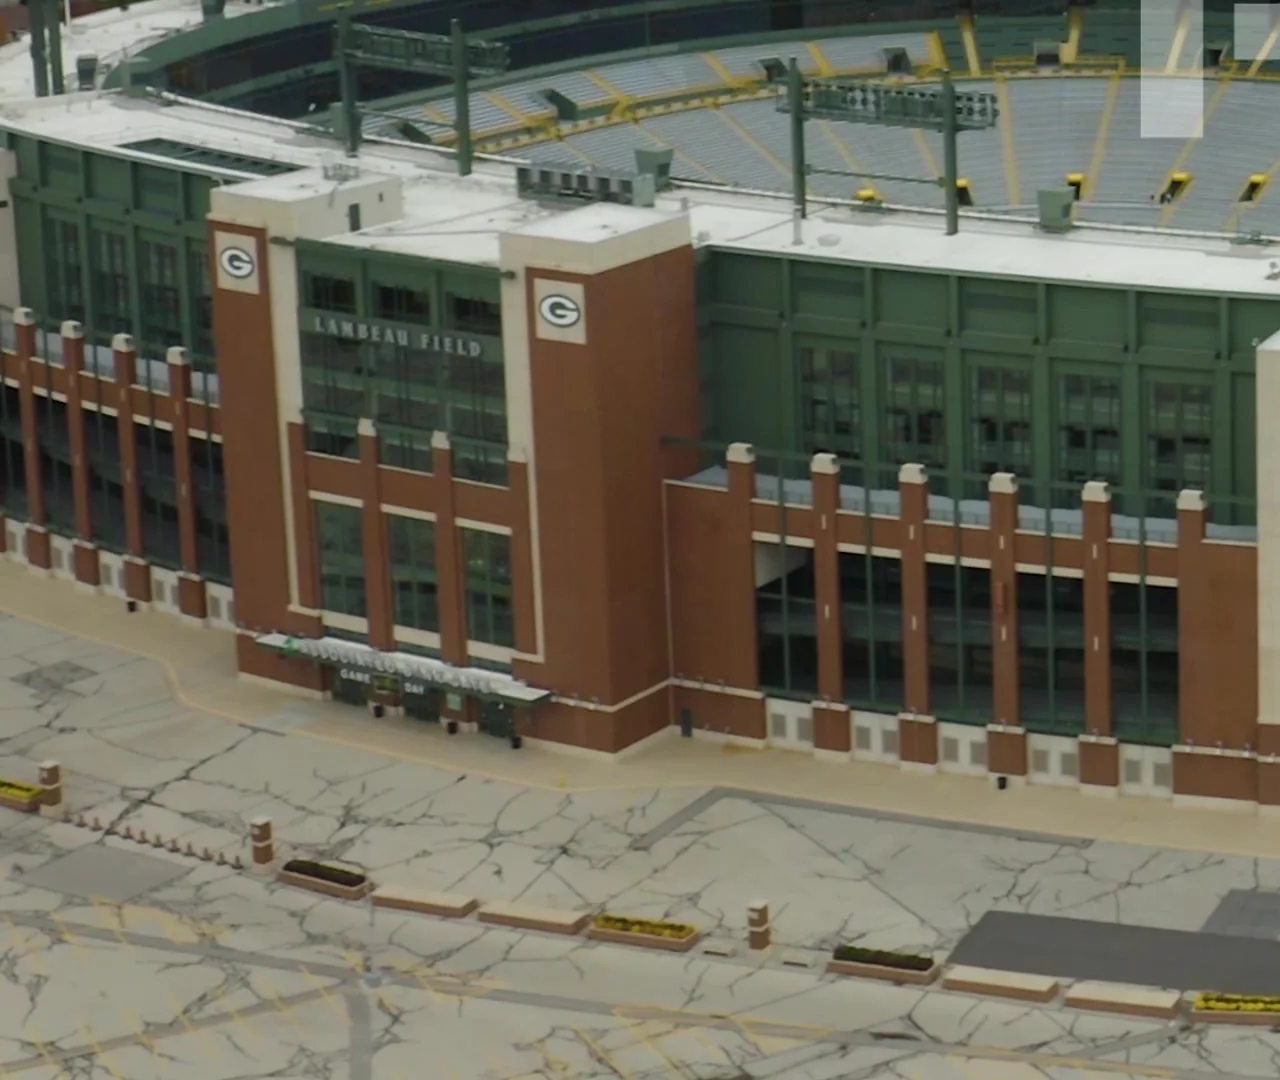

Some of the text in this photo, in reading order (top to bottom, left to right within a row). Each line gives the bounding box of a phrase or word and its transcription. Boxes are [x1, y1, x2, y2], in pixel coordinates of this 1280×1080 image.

[221, 247, 254, 278] G
[540, 295, 580, 327] G
[315, 317, 481, 357] LAMBEAU FIELD
[340, 668, 370, 684] GAME
